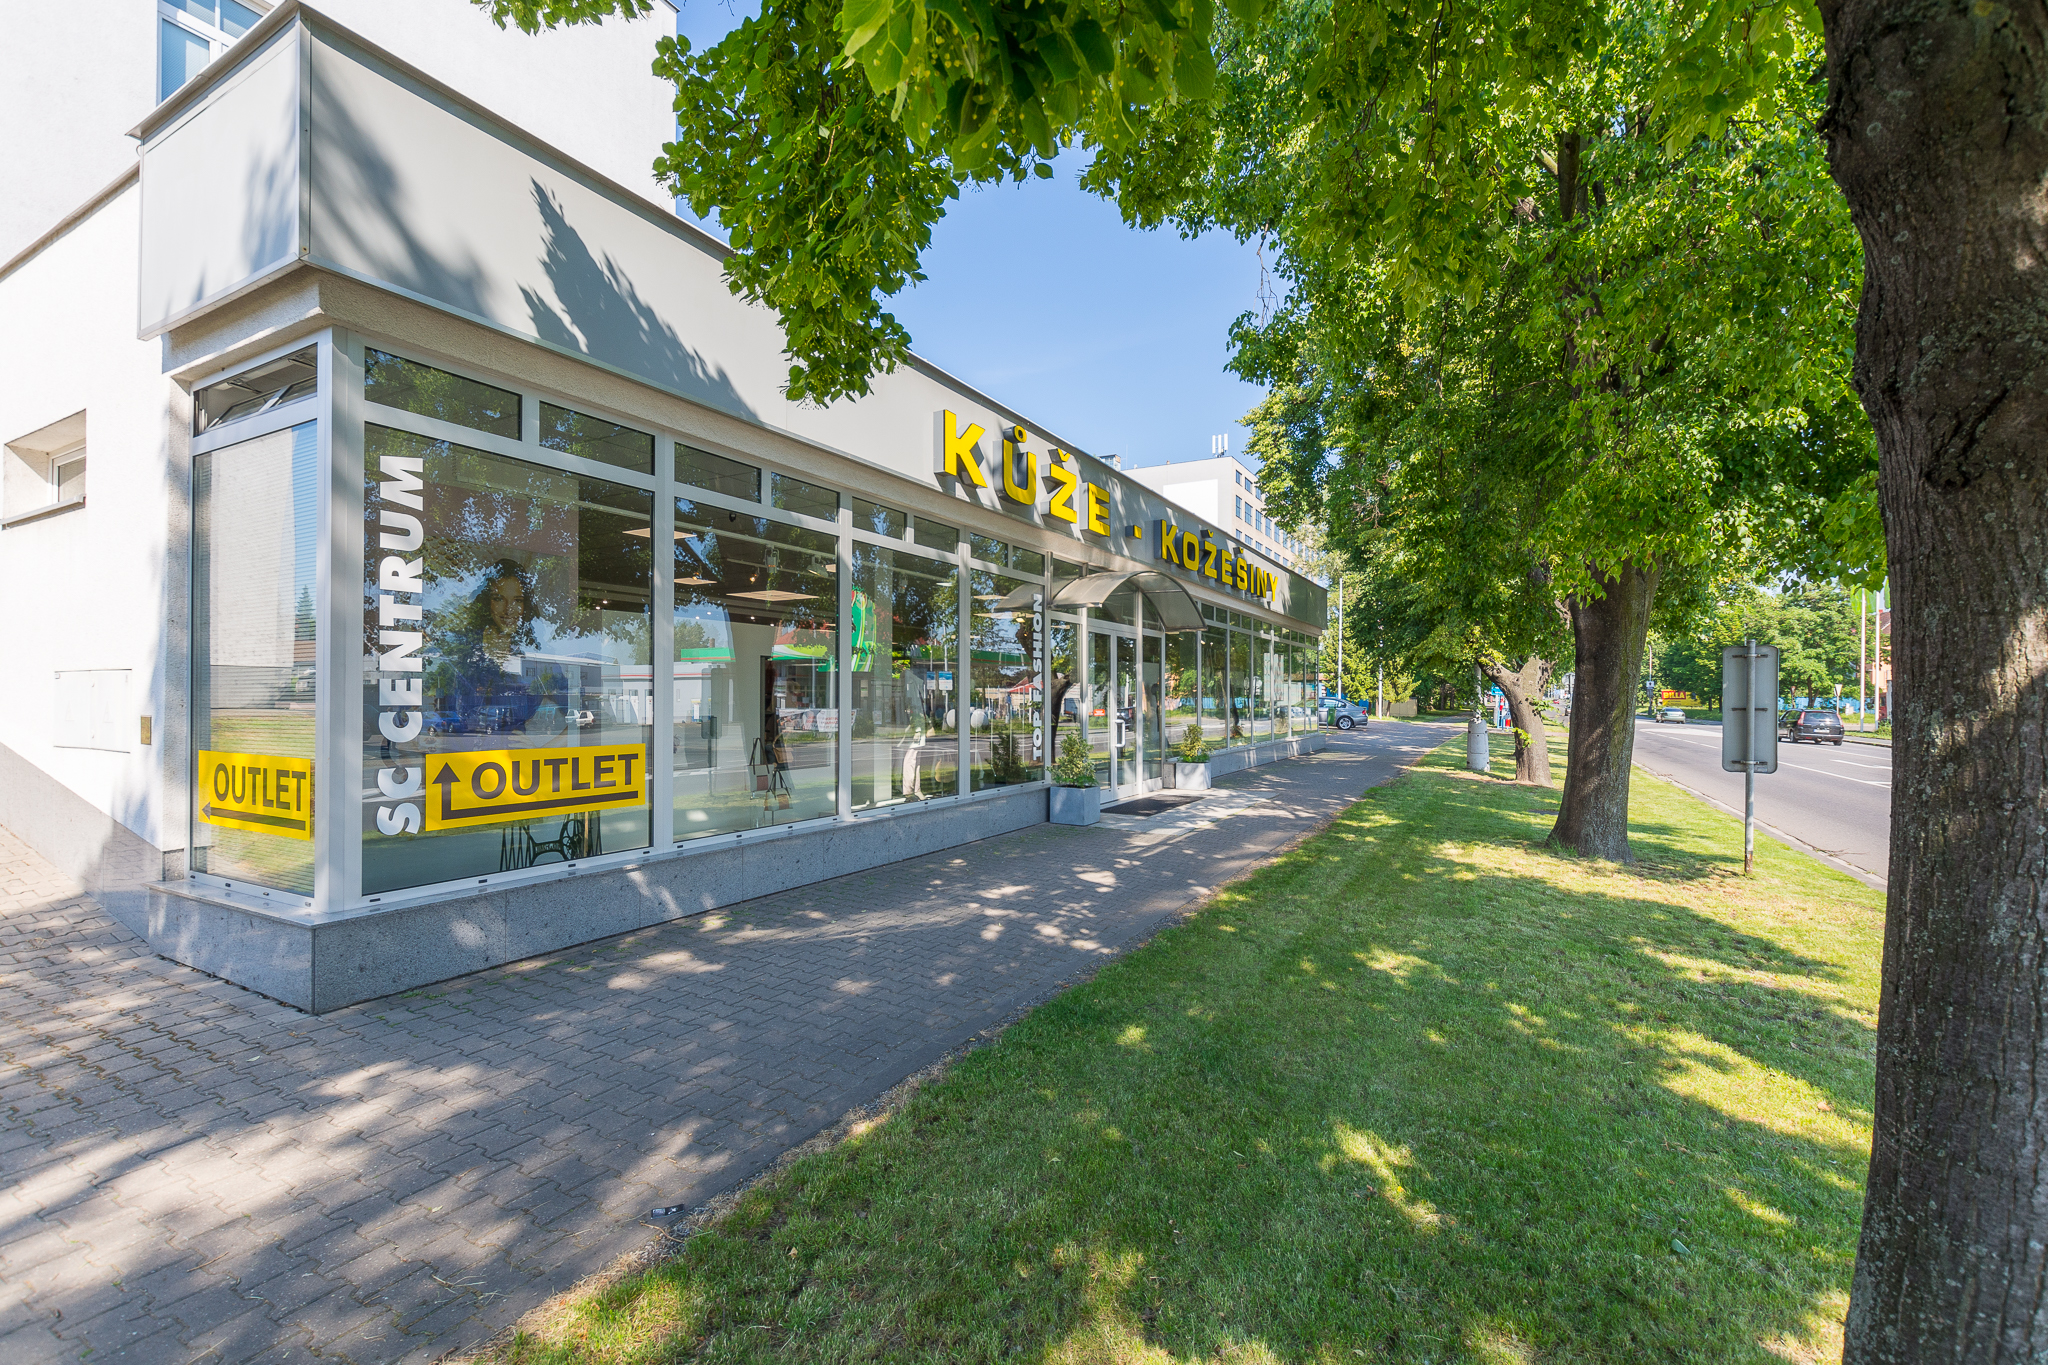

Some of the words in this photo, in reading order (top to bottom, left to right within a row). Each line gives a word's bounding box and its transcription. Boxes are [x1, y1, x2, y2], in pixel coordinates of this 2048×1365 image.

[942, 409, 1111, 537] KŮŽE
[1160, 519, 1279, 602] KOŽEŠINY
[379, 455, 423, 743] CENTRUM
[1033, 593, 1043, 702] FASHION
[1663, 691, 1685, 699] BILLA
[1033, 706, 1043, 761] TOP
[213, 762, 307, 813] OUTLET
[377, 766, 422, 836] SC
[470, 753, 639, 800] OUTLET
